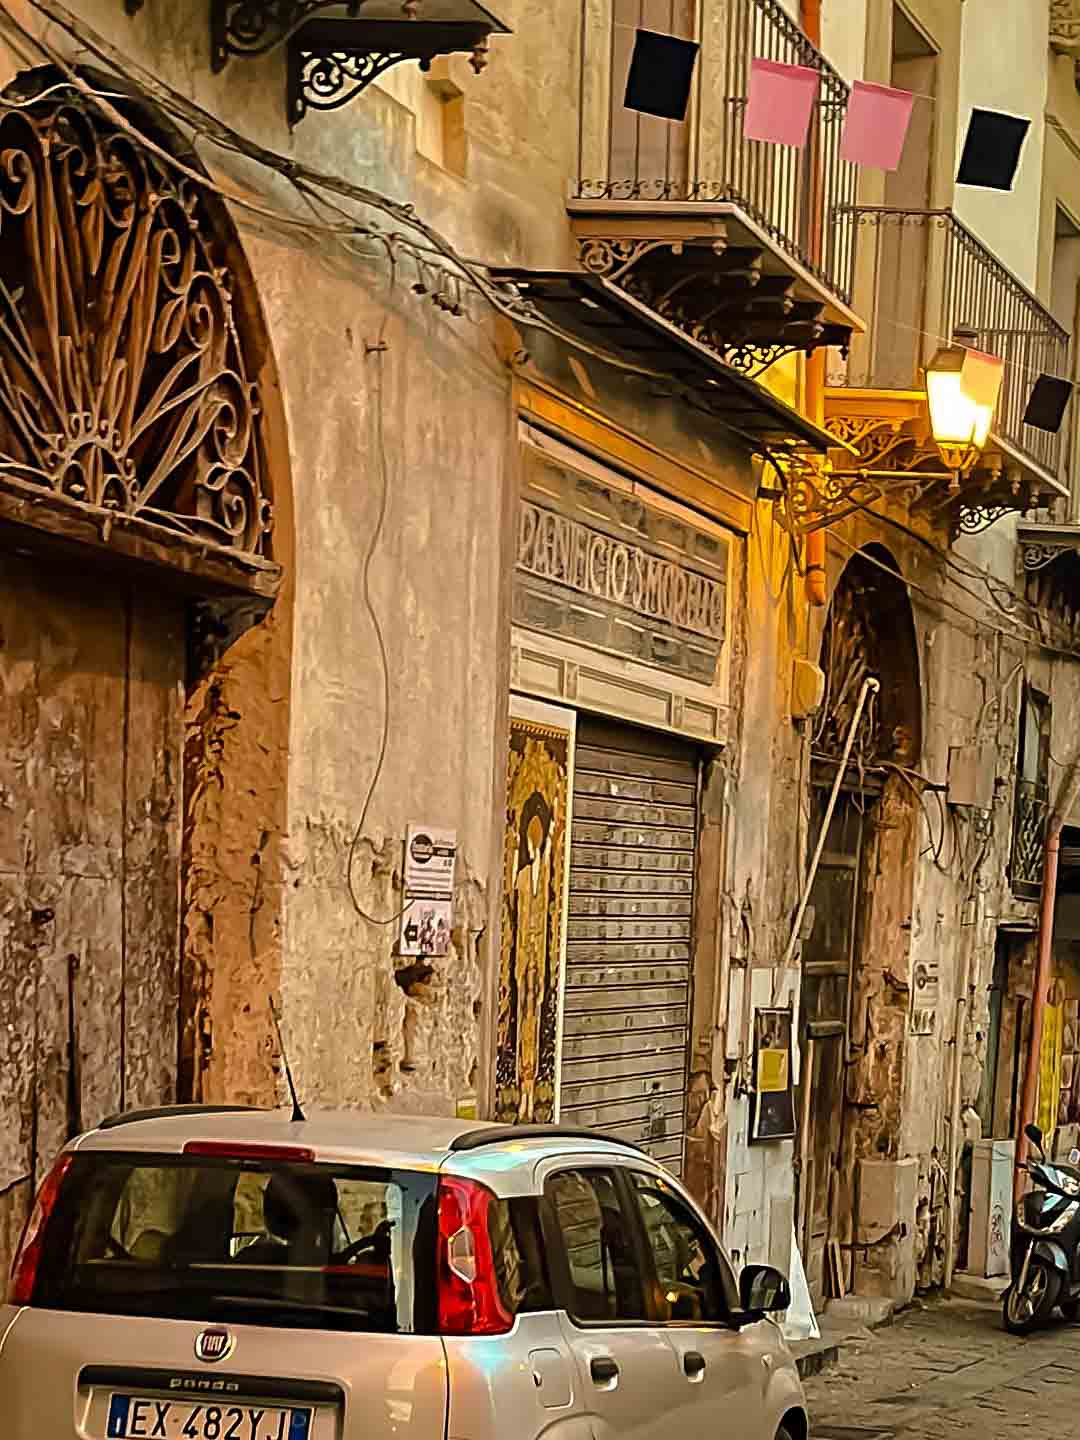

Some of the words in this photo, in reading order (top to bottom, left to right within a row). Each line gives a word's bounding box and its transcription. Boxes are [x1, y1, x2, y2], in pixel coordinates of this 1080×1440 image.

[518, 507, 629, 602] PANIFICIO
[202, 1335, 225, 1353] FIAT
[169, 1377, 240, 1392] panda
[130, 1401, 171, 1437] EX
